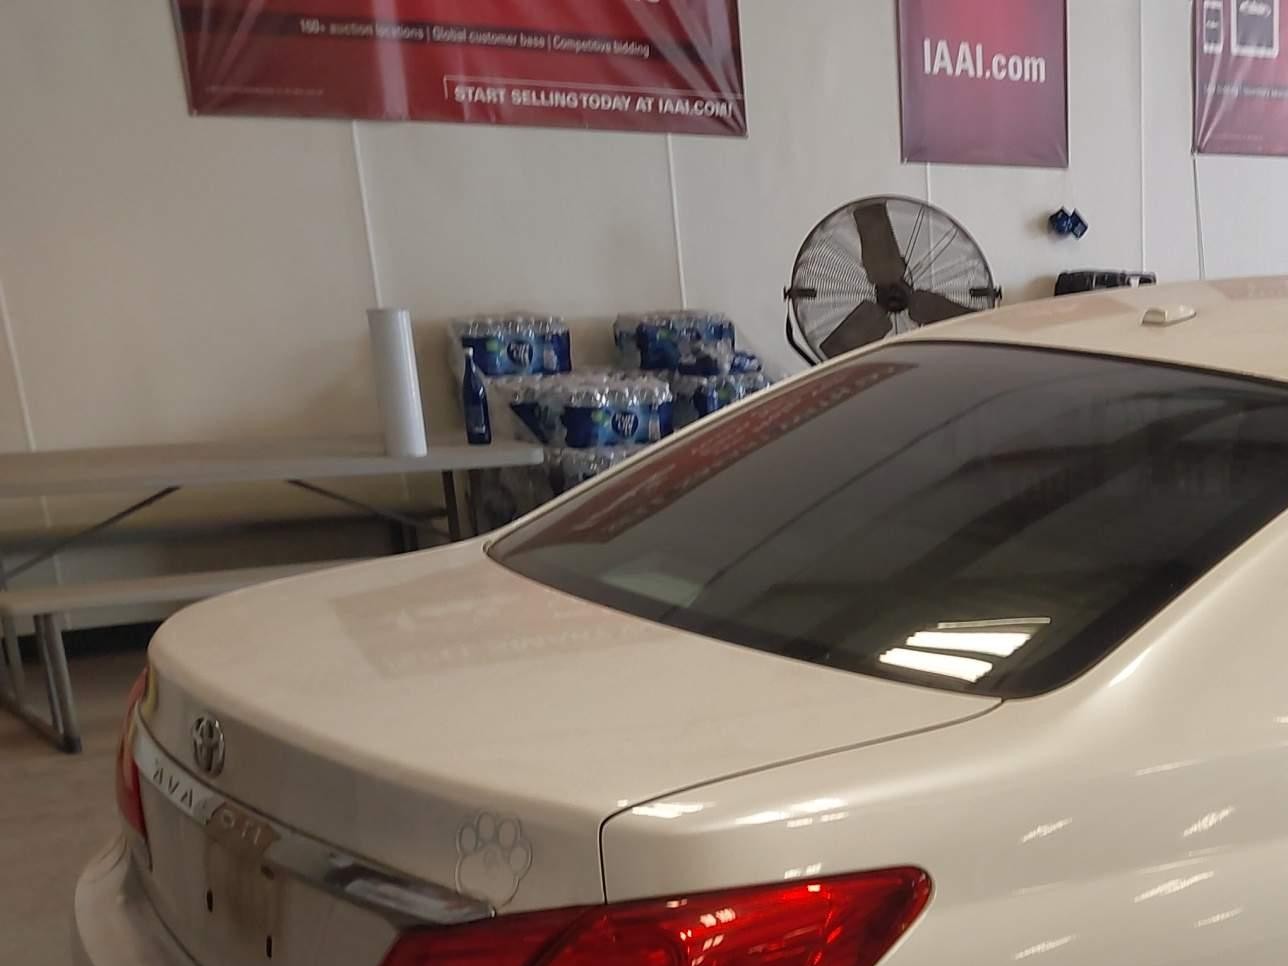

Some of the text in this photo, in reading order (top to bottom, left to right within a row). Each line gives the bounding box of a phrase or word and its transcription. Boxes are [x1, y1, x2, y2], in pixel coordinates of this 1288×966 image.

[432, 26, 466, 42] Global
[469, 31, 517, 45] customer
[520, 32, 545, 48] base
[553, 34, 612, 54] Competitive
[613, 40, 650, 59] bidding
[923, 37, 1046, 83] IAAI.com
[454, 86, 505, 103] START
[511, 89, 578, 108] SELLING
[582, 92, 630, 112] TODAY
[635, 96, 653, 112] AT
